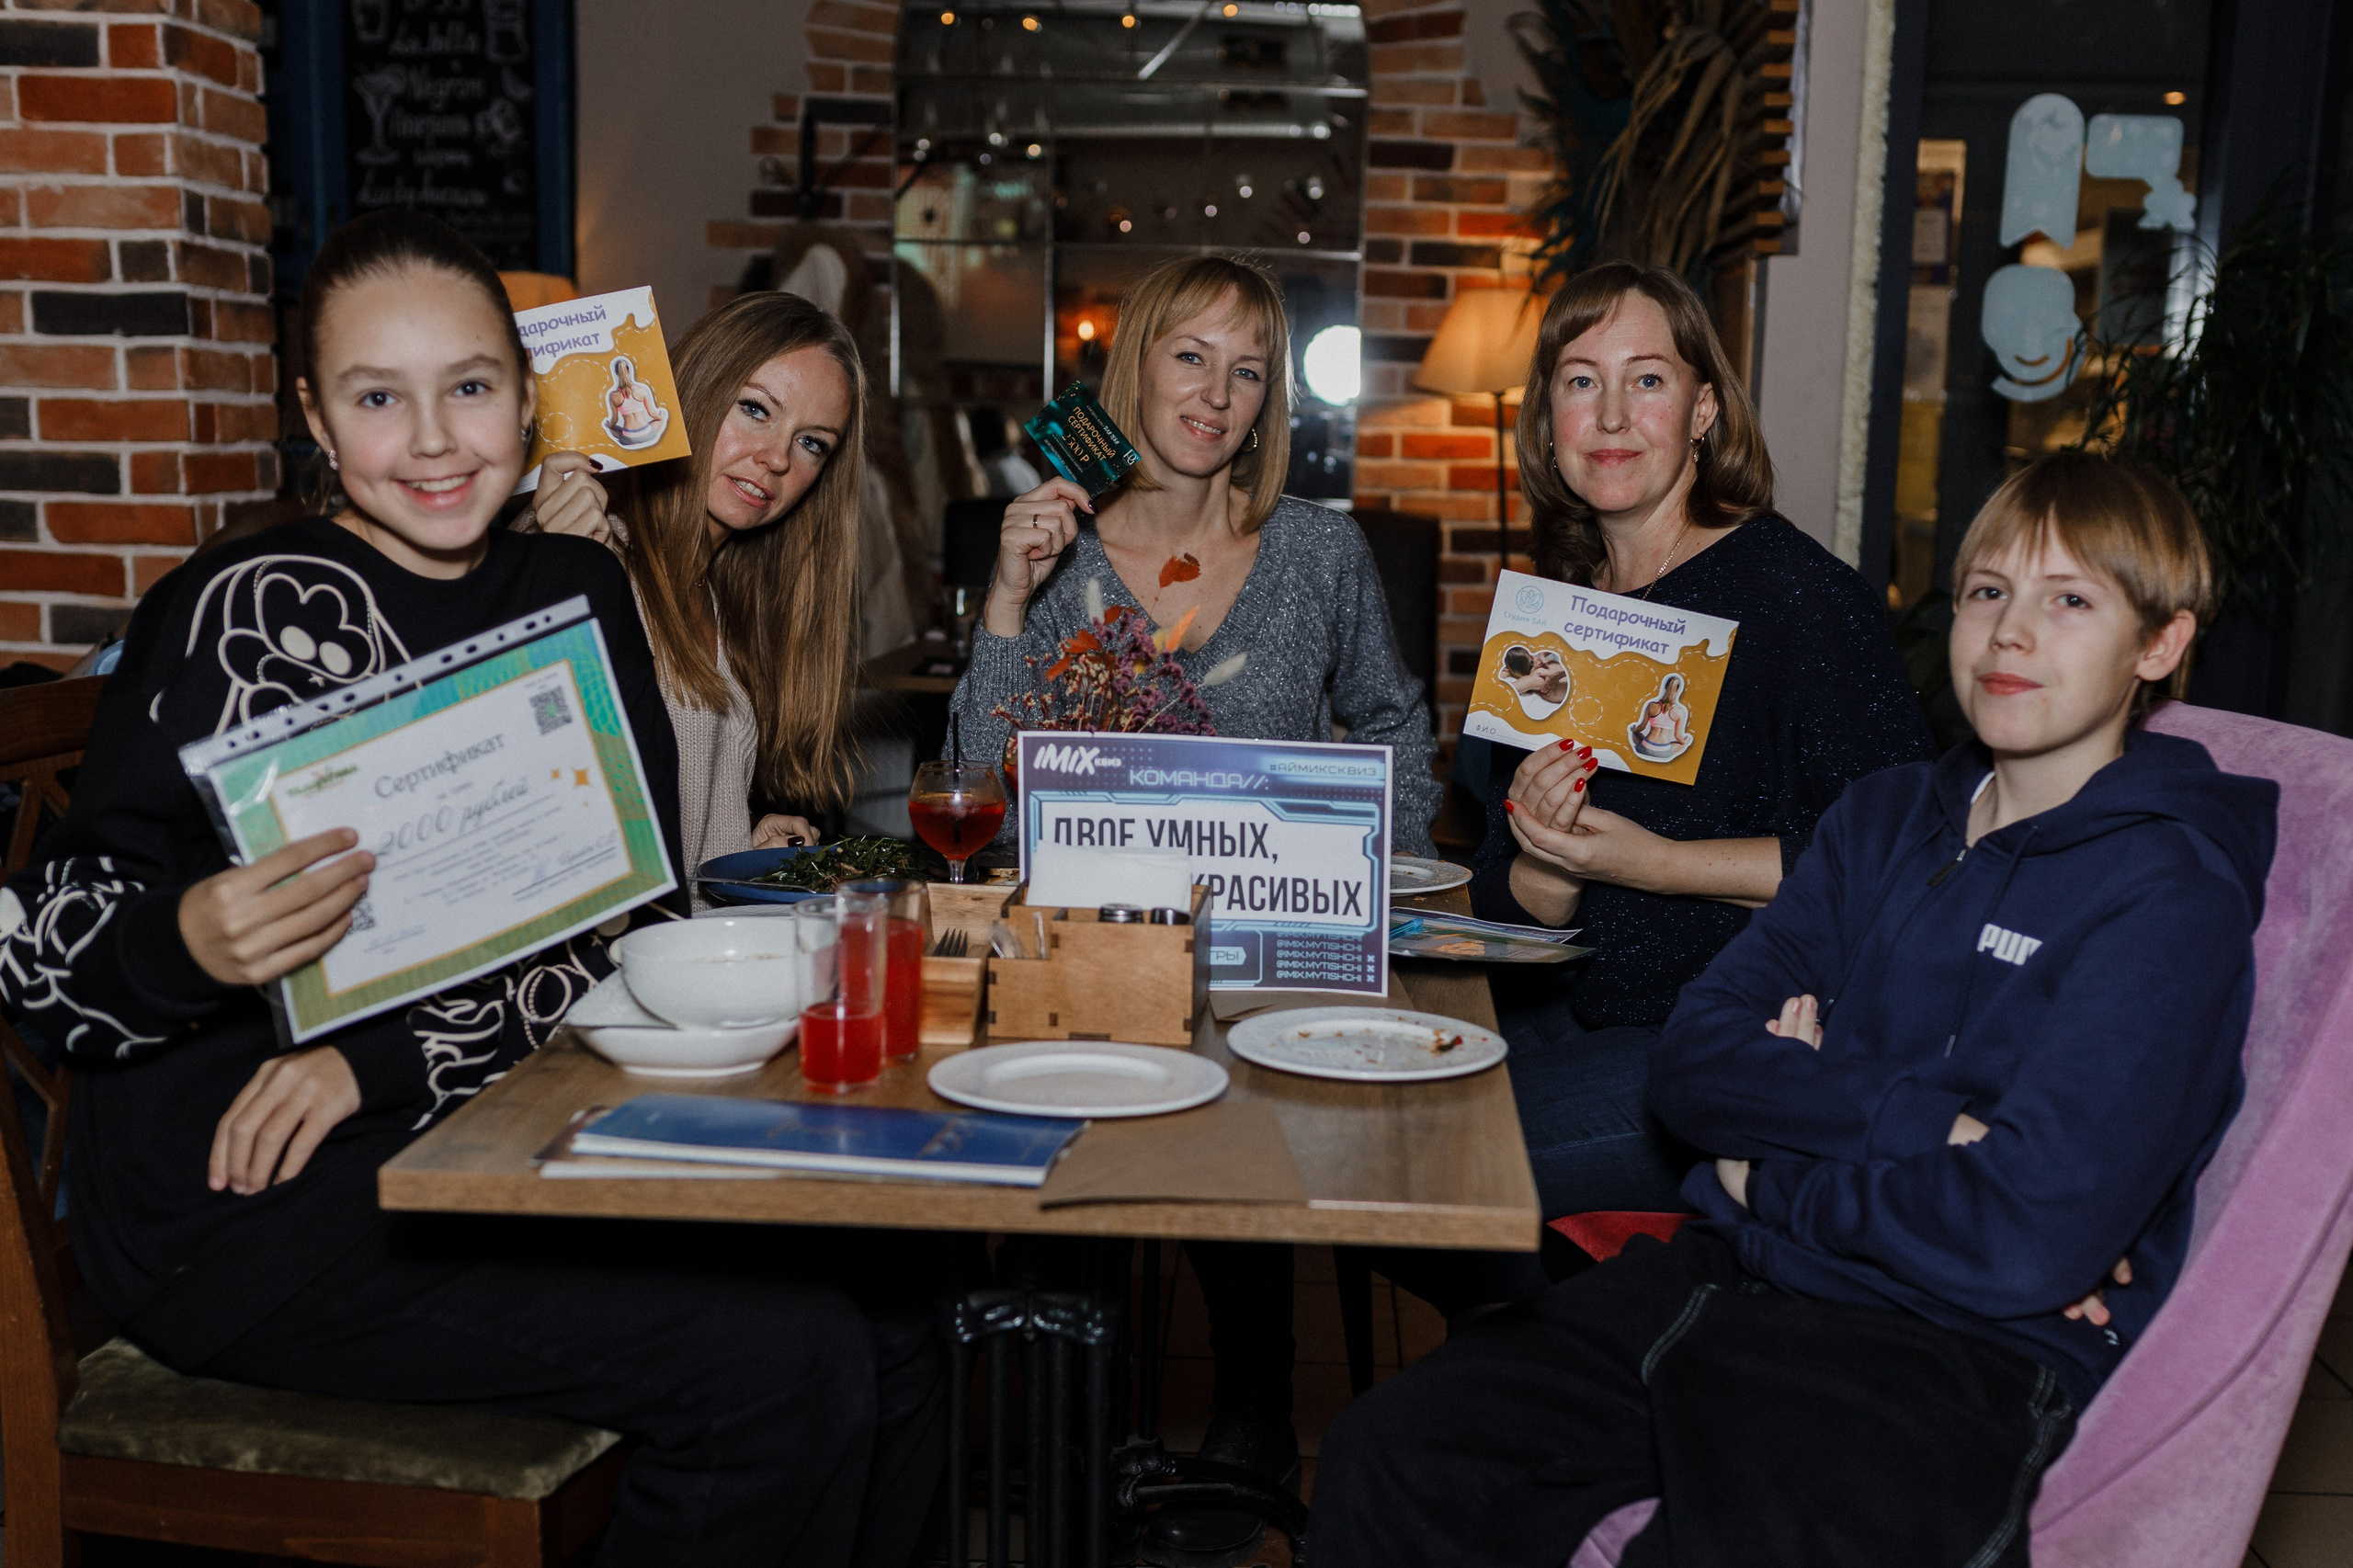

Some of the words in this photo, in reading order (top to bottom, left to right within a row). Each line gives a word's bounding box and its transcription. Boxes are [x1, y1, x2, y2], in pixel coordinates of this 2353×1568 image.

[1062, 433, 1084, 456] 2500
[1068, 415, 1107, 461] СЕРТИФИКАТ
[1073, 406, 1117, 459] ПОДАРОЧНЫЙ
[1503, 611, 1530, 623] Студия
[1571, 595, 1687, 635] Подарочный
[1563, 620, 1670, 655] сертификат
[373, 734, 505, 799] Сертификат
[1269, 762, 1377, 777] #АЙМИКСКВИЗ
[1146, 818, 1279, 864] УМНЫХ,
[1211, 950, 1239, 960] РЫ
